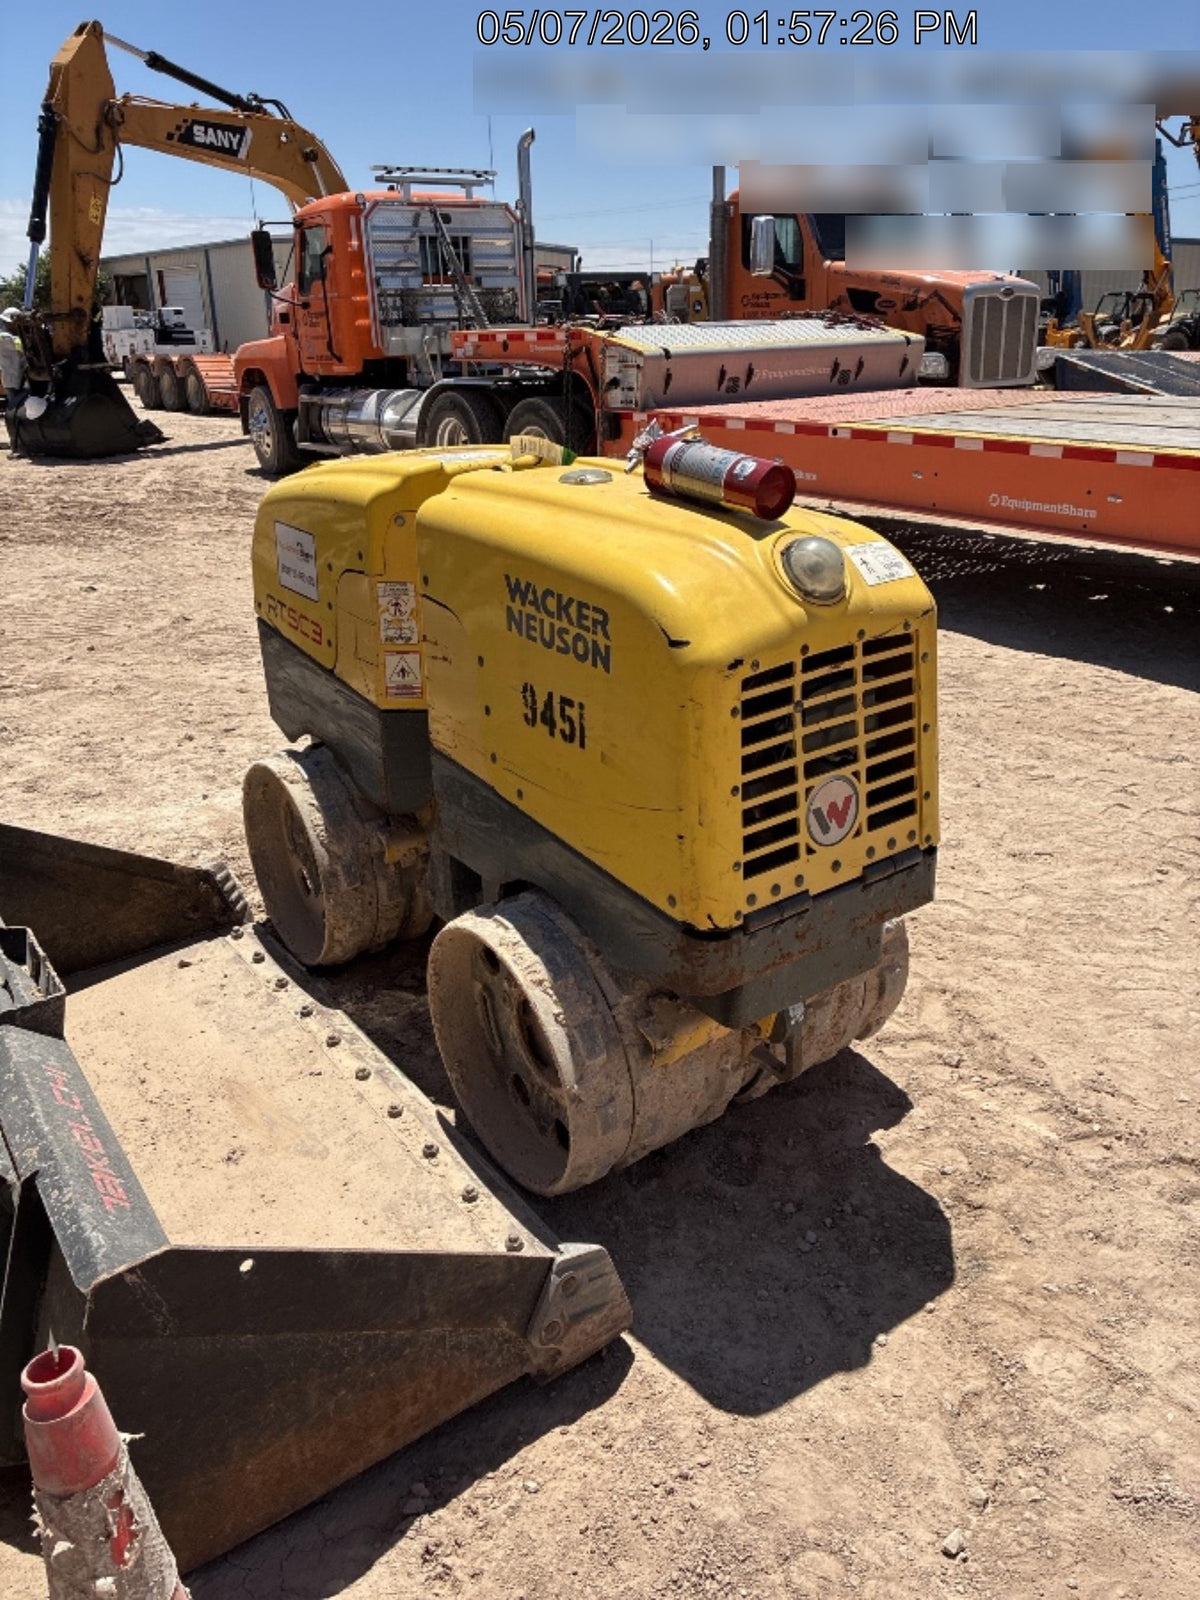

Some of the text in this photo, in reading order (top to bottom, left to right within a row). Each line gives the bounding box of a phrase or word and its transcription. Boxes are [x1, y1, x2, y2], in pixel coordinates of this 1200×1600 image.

[192, 124, 240, 150] SANY
[1001, 495, 1097, 519] EquipmentShare
[504, 573, 612, 642] WACKER
[506, 605, 611, 674] NEUSON
